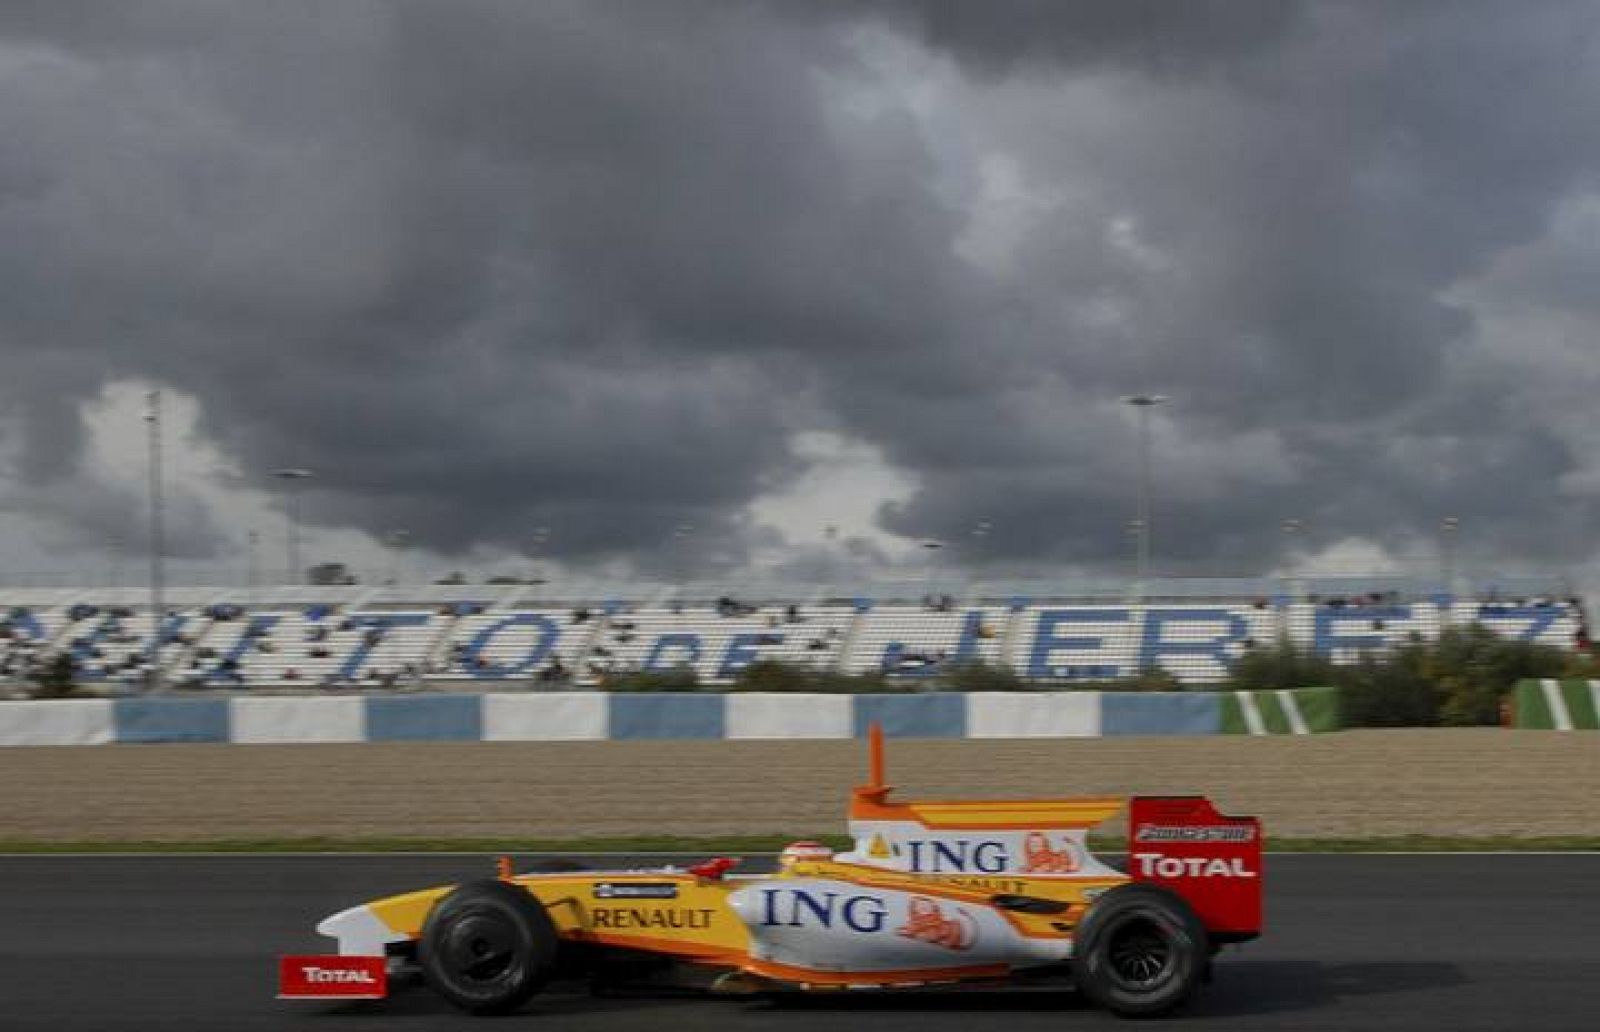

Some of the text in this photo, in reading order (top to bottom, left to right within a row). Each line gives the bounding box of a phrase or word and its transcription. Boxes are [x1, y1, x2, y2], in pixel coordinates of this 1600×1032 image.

[906, 840, 1011, 873] ING
[1133, 853, 1257, 877] TOTAL
[592, 909, 717, 928] RENAULT
[759, 888, 890, 933] ING
[301, 967, 376, 983] TOTAL
